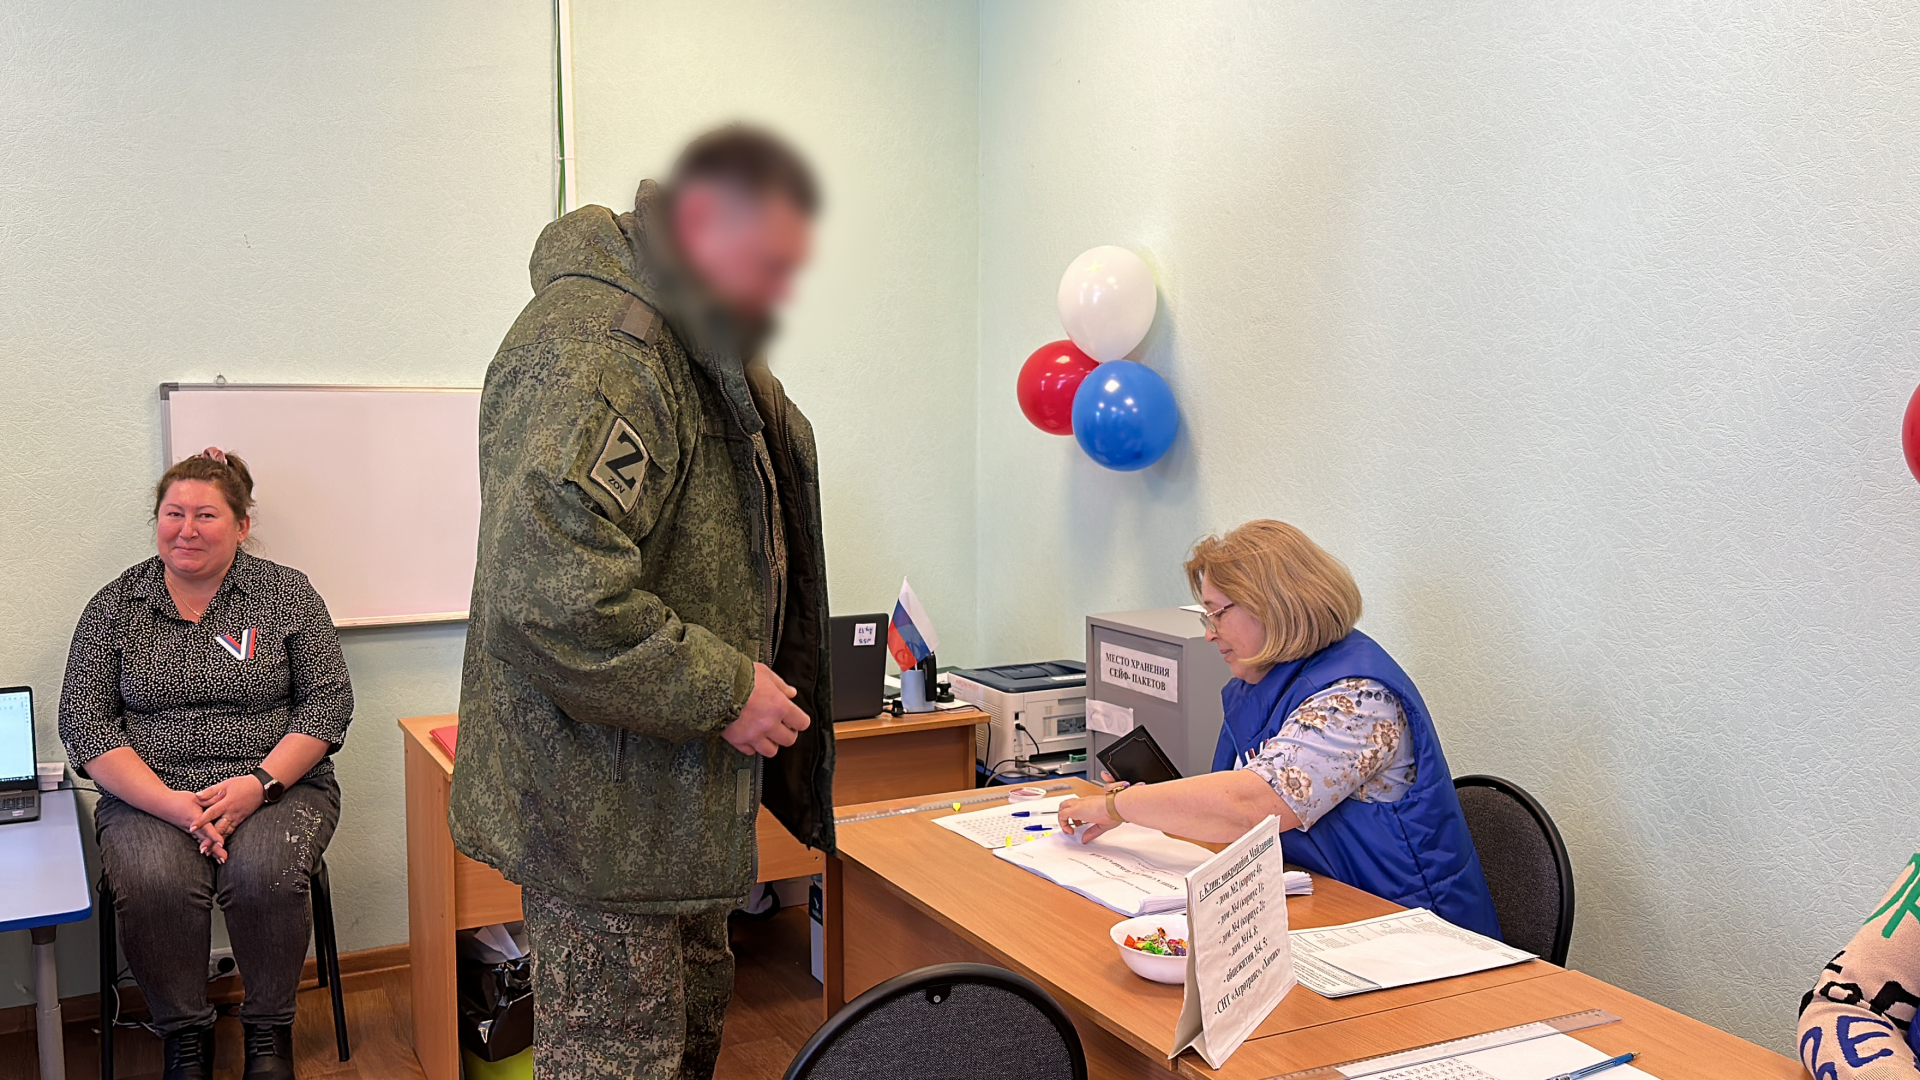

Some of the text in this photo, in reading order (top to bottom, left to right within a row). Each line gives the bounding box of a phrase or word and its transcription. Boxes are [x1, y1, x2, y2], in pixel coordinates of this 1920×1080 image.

[605, 430, 644, 491] Z
[608, 475, 626, 494] ZOV
[1105, 652, 1170, 678] МЕСТО ХРАНЕНИЯ
[1109, 667, 1166, 691] СЕЙФ- ПАКЕТОВ
[1239, 869, 1256, 891] (корпус
[1240, 888, 1258, 910] (корпус
[1240, 906, 1259, 928] (корпус
[1217, 992, 1231, 1014] СНТ
